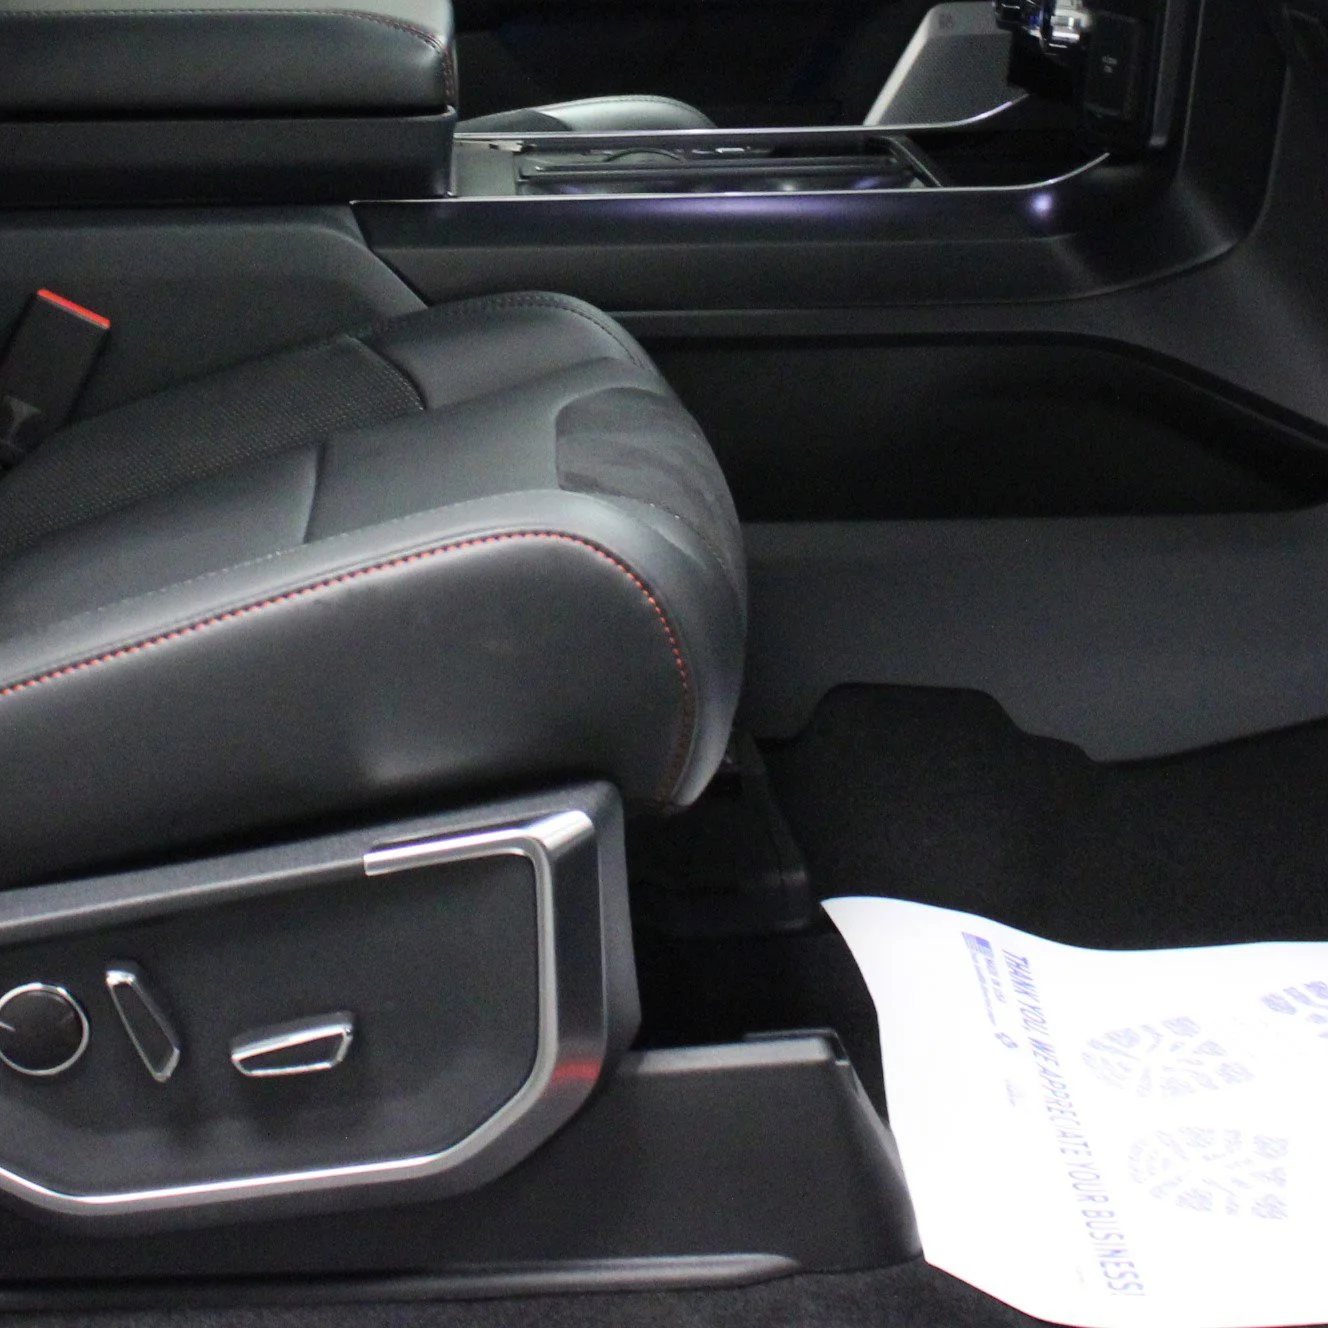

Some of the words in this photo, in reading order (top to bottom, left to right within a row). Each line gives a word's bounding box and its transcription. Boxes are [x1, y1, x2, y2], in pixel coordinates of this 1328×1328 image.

[1002, 949, 1040, 1003] THANK
[1028, 1036, 1059, 1066] WE
[1036, 1062, 1092, 1156] APPRECIATE
[1064, 1161, 1109, 1203] YOUR
[1081, 1209, 1145, 1296] BUSINESS!
